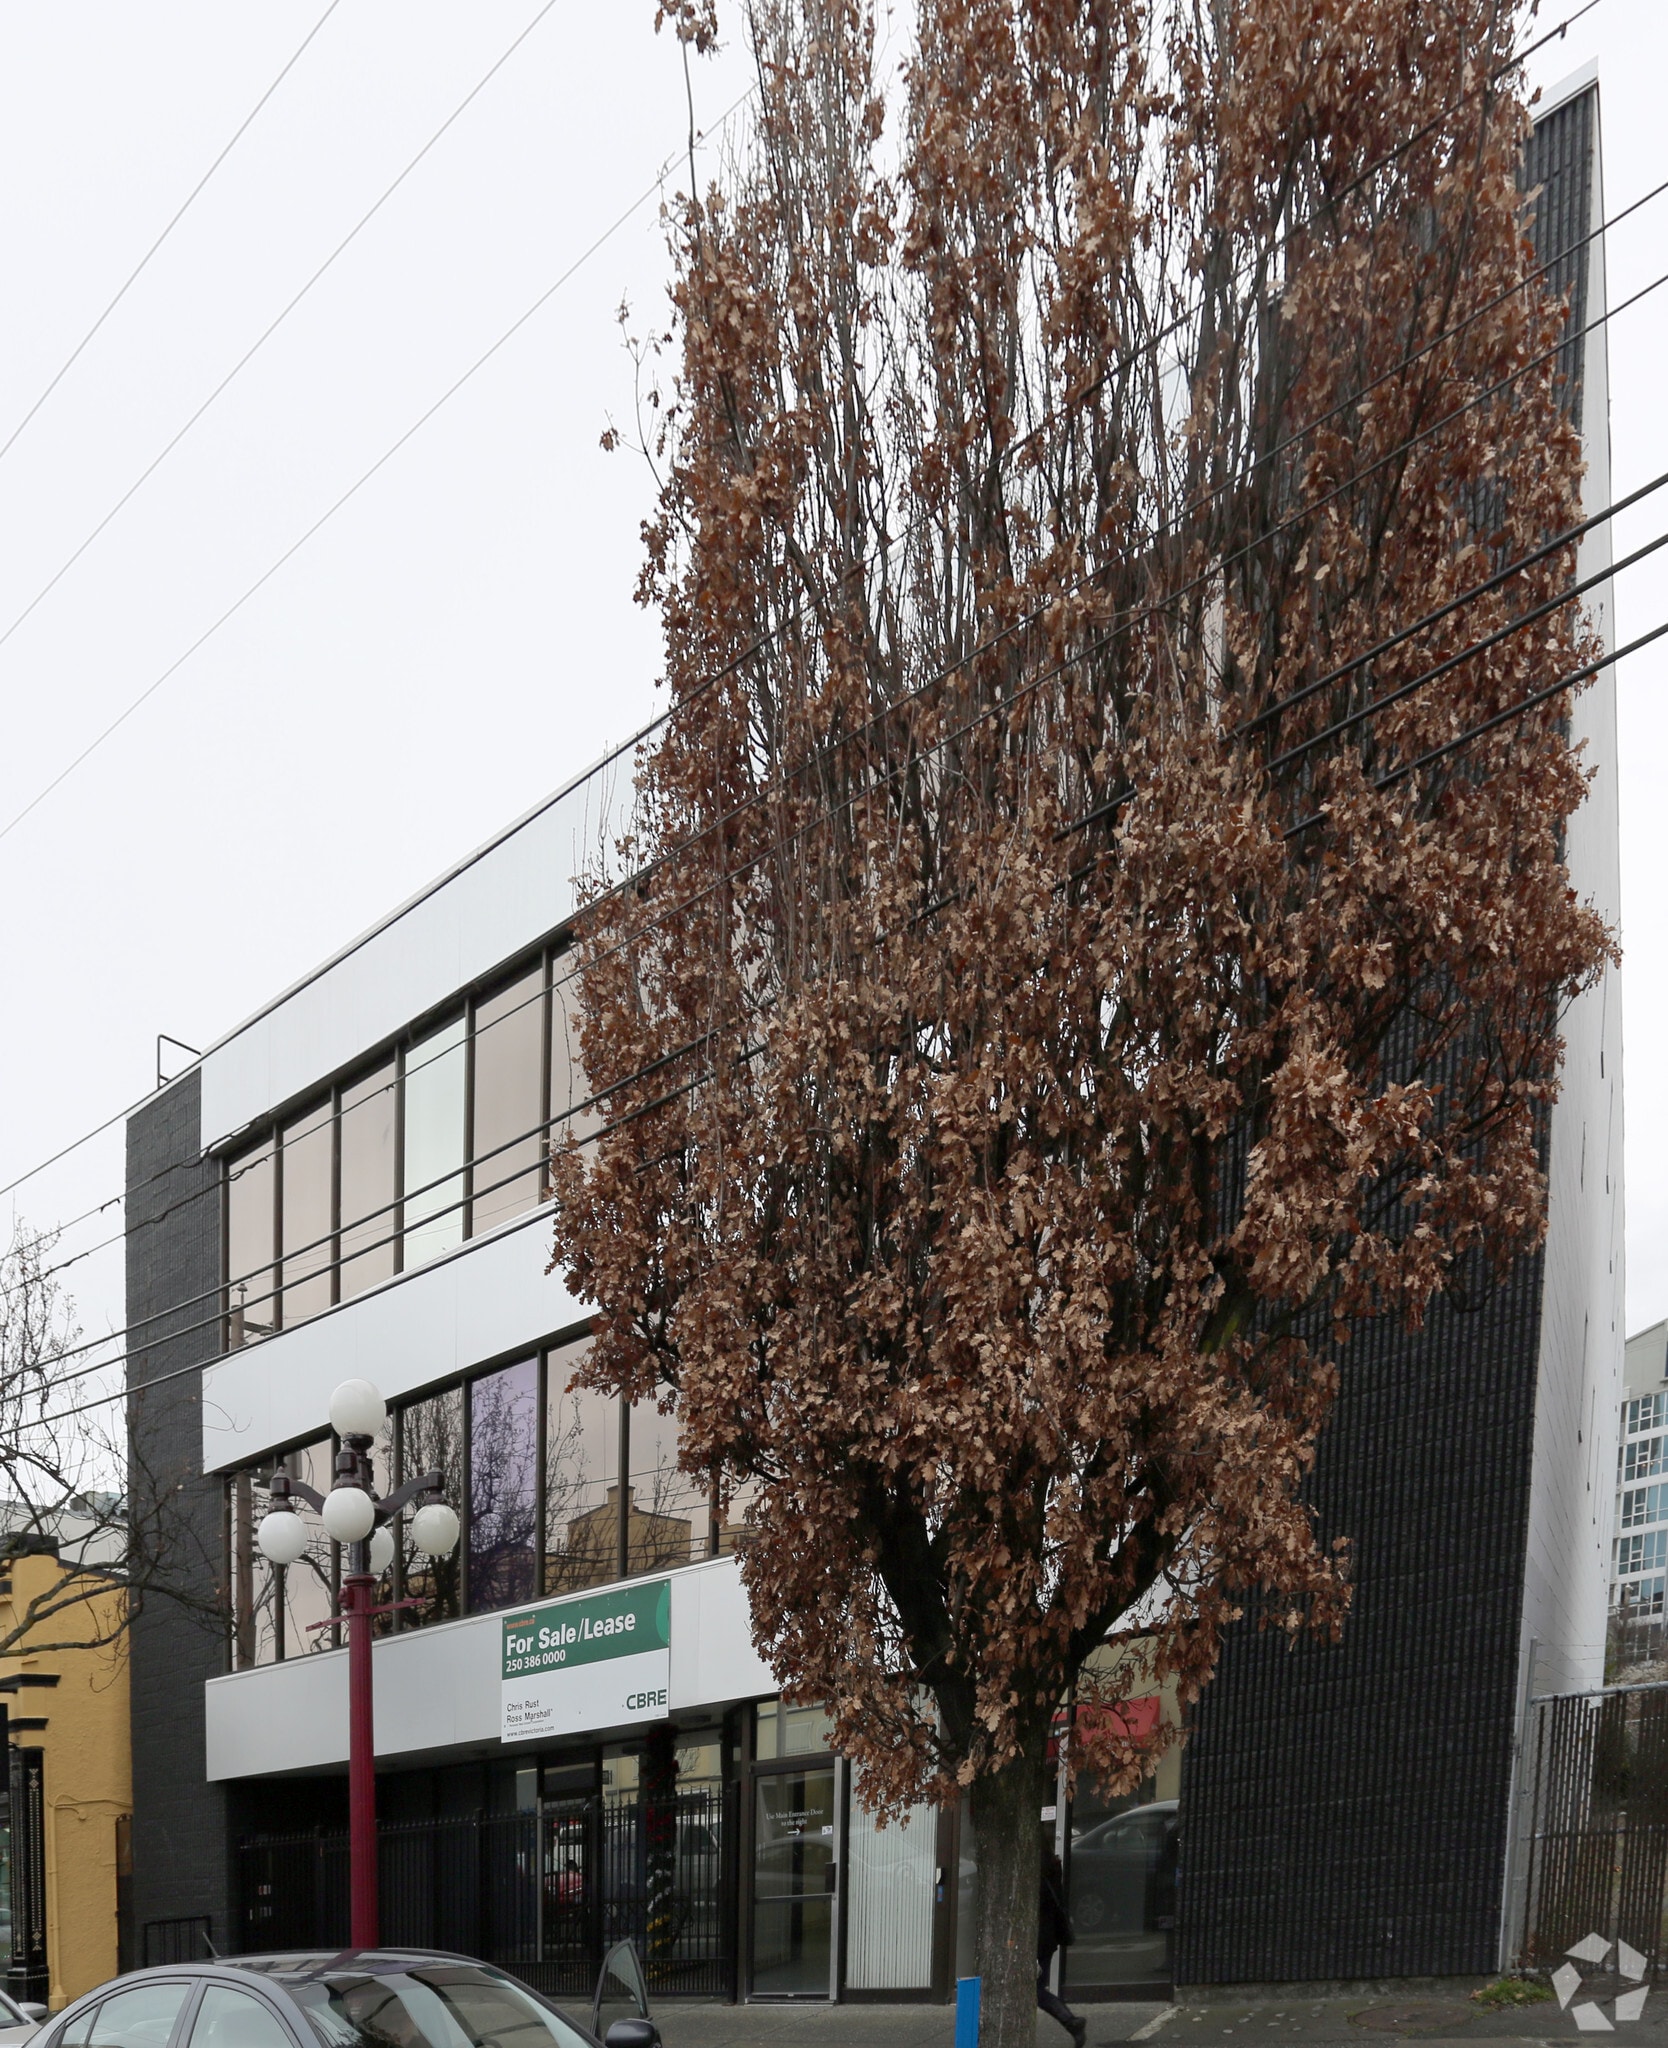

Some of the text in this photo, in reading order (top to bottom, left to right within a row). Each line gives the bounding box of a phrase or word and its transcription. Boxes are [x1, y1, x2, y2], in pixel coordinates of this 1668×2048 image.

[506, 1634, 534, 1657] For
[506, 1649, 566, 1673] 250 386 0000
[507, 1699, 539, 1712] Chris Rust
[626, 1689, 667, 1710] CBRE
[506, 1714, 523, 1724] Ross
[775, 1811, 788, 1819] Main
[795, 1818, 808, 1827] right
